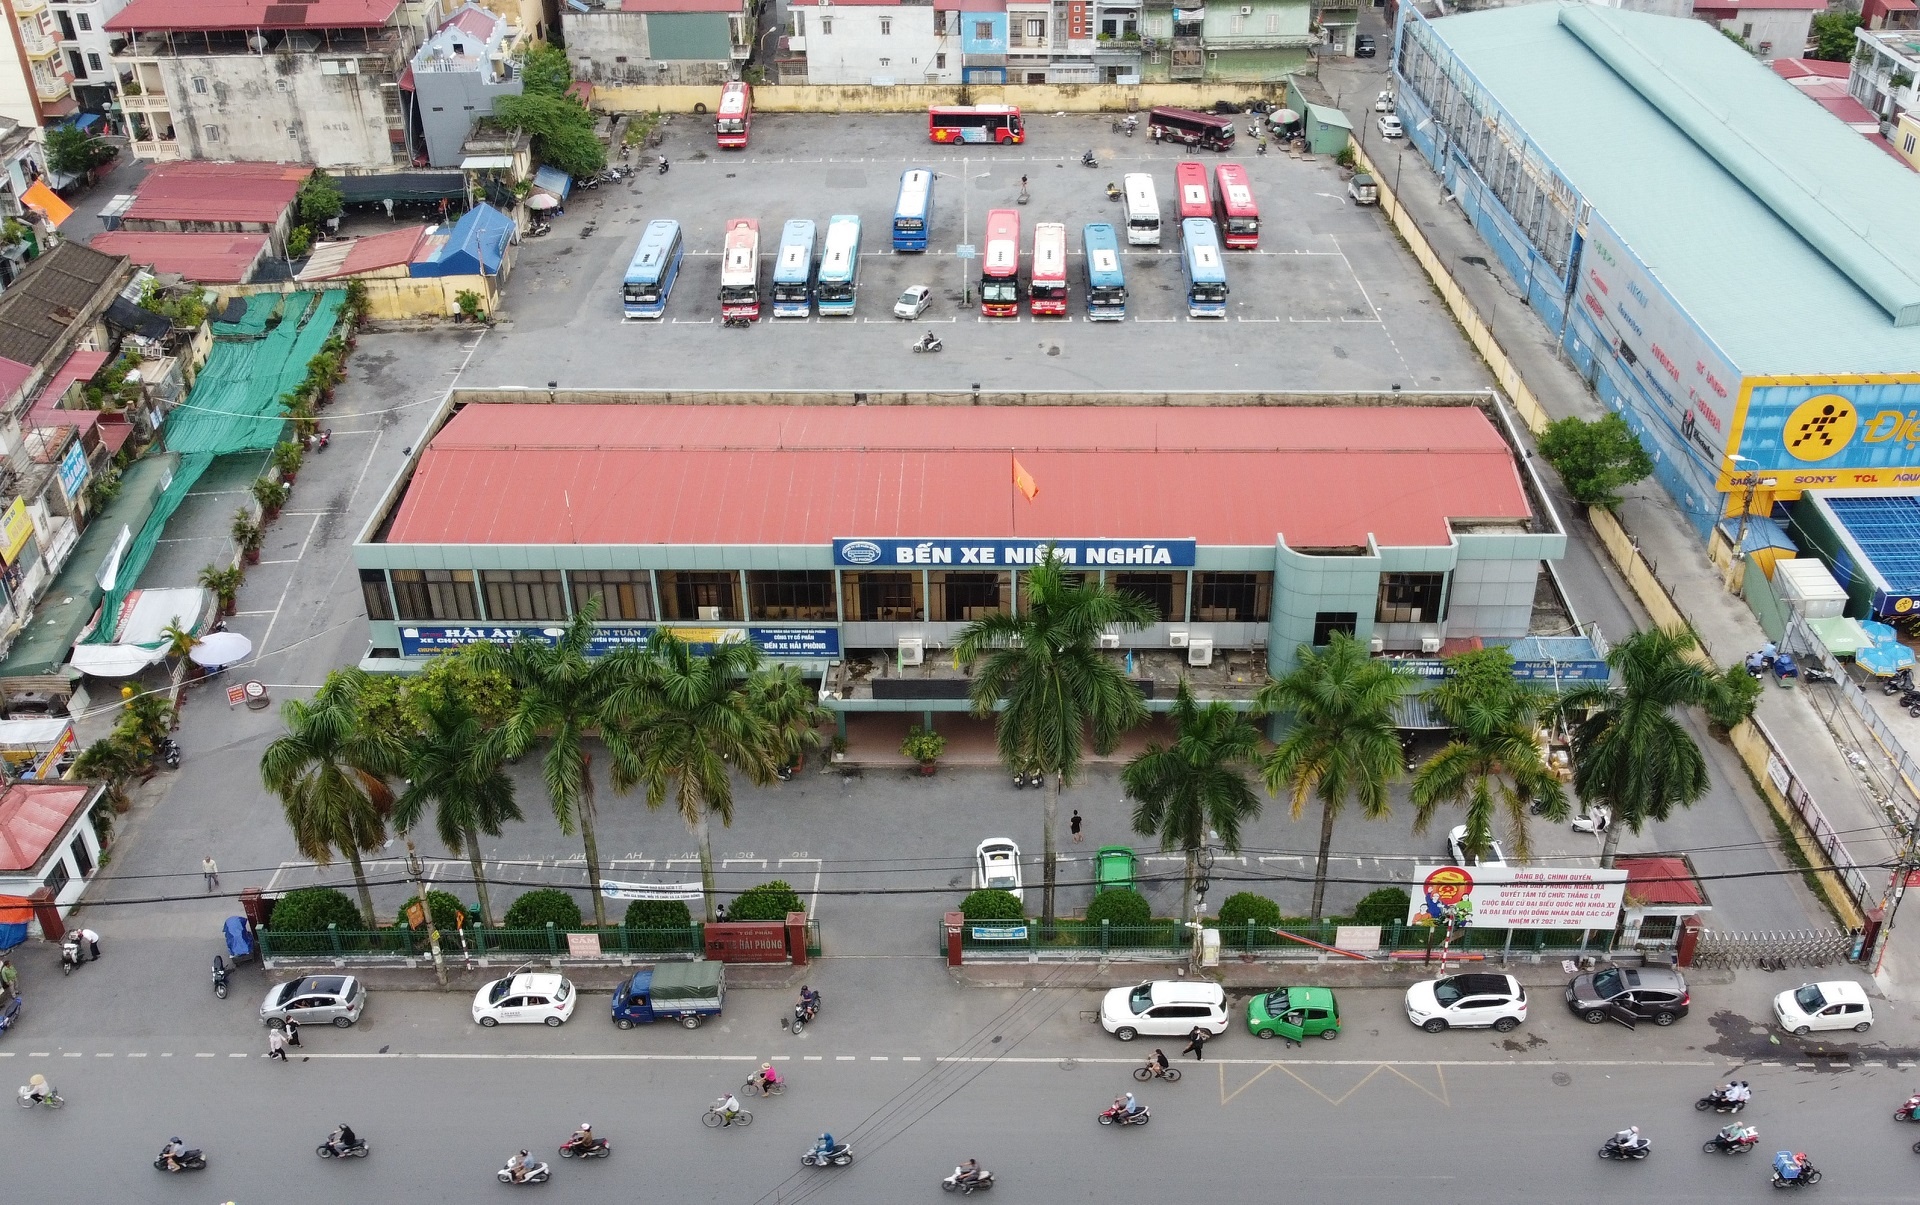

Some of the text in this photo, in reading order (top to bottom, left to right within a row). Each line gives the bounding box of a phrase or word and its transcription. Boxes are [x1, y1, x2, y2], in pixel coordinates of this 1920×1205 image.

[1696, 360, 1727, 398] SARP
[1689, 385, 1721, 433] TSHIBA
[1793, 475, 1838, 484] SONY
[1854, 474, 1879, 482] TCL
[896, 542, 952, 565] BẾN
[960, 547, 996, 564] XE
[1086, 544, 1173, 564] NGHĨA
[445, 627, 521, 638] HẢI ÂU
[764, 641, 778, 649] BẾN
[790, 641, 801, 649] HẢI
[803, 641, 827, 649] PHÒNG
[1547, 873, 1568, 881] CHÍNH
[1500, 890, 1521, 898] QUYẾT
[1567, 890, 1589, 899] THẮNG
[1538, 899, 1555, 907] BIỂU
[1555, 900, 1574, 908] QUỐC
[1519, 909, 1530, 917] HỘI
[571, 935, 597, 944] CẤM
[740, 938, 753, 949] HẢI
[755, 939, 783, 949] PHÒNG
